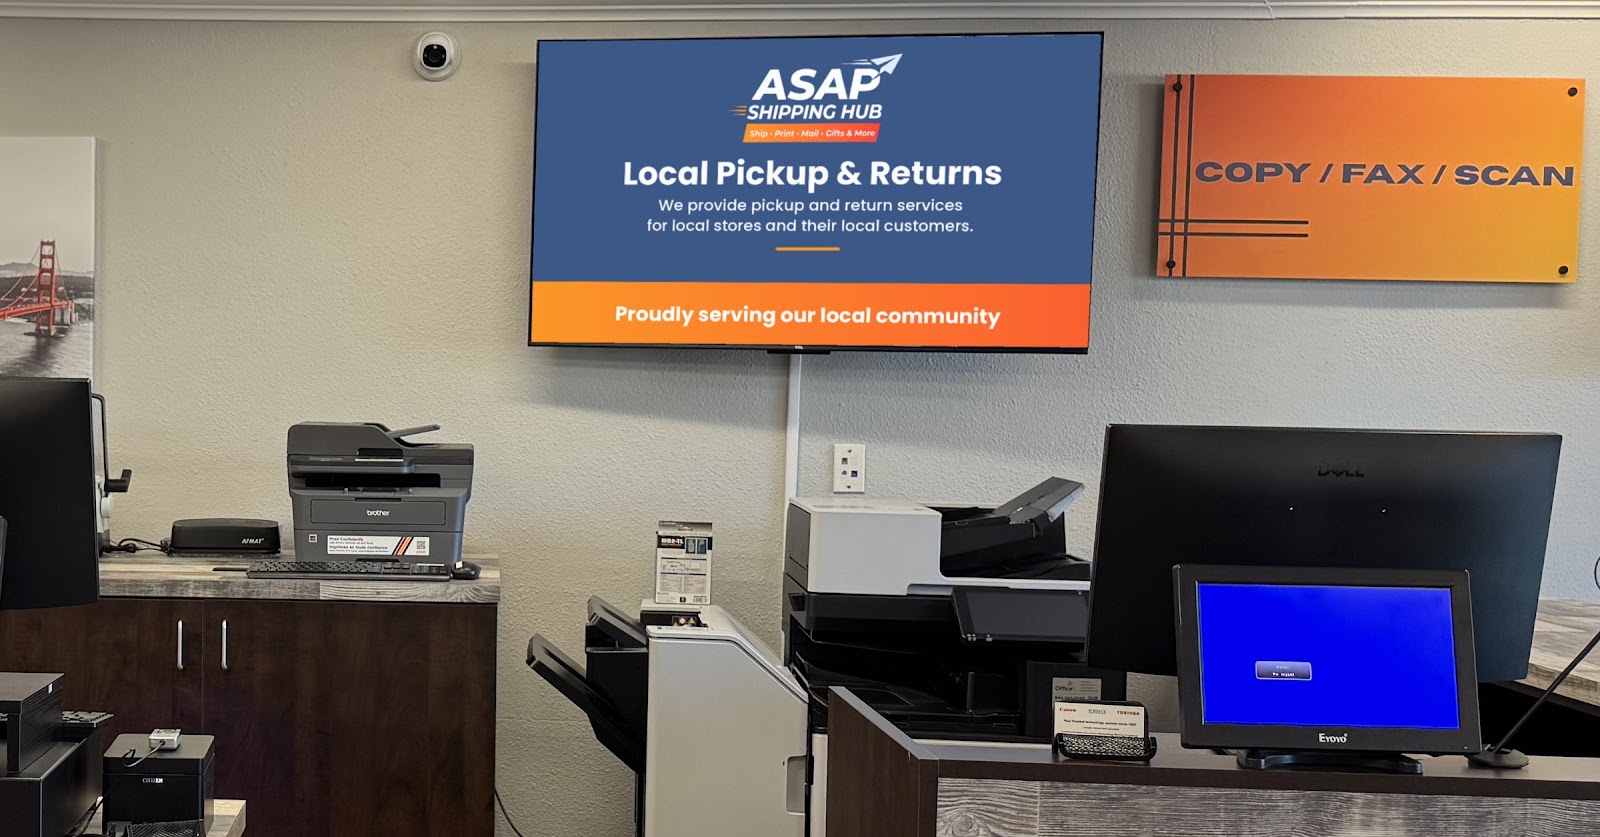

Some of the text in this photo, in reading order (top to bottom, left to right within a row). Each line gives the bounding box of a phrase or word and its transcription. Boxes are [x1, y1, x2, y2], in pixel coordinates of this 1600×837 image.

[751, 68, 882, 101] ASAP
[747, 104, 882, 120] SHIPPING HUB
[750, 130, 768, 138] Ship
[826, 129, 844, 137] Gifts
[854, 129, 876, 137] More
[623, 159, 1002, 193] Local Pickup & Returns
[1194, 161, 1574, 187] COPY / FAX / SCAN
[658, 198, 963, 216] We provide pickup and return services
[647, 218, 974, 233] for local stores and their local customers.
[615, 305, 1001, 330] Proudly serving our local community
[366, 509, 390, 517] brother
